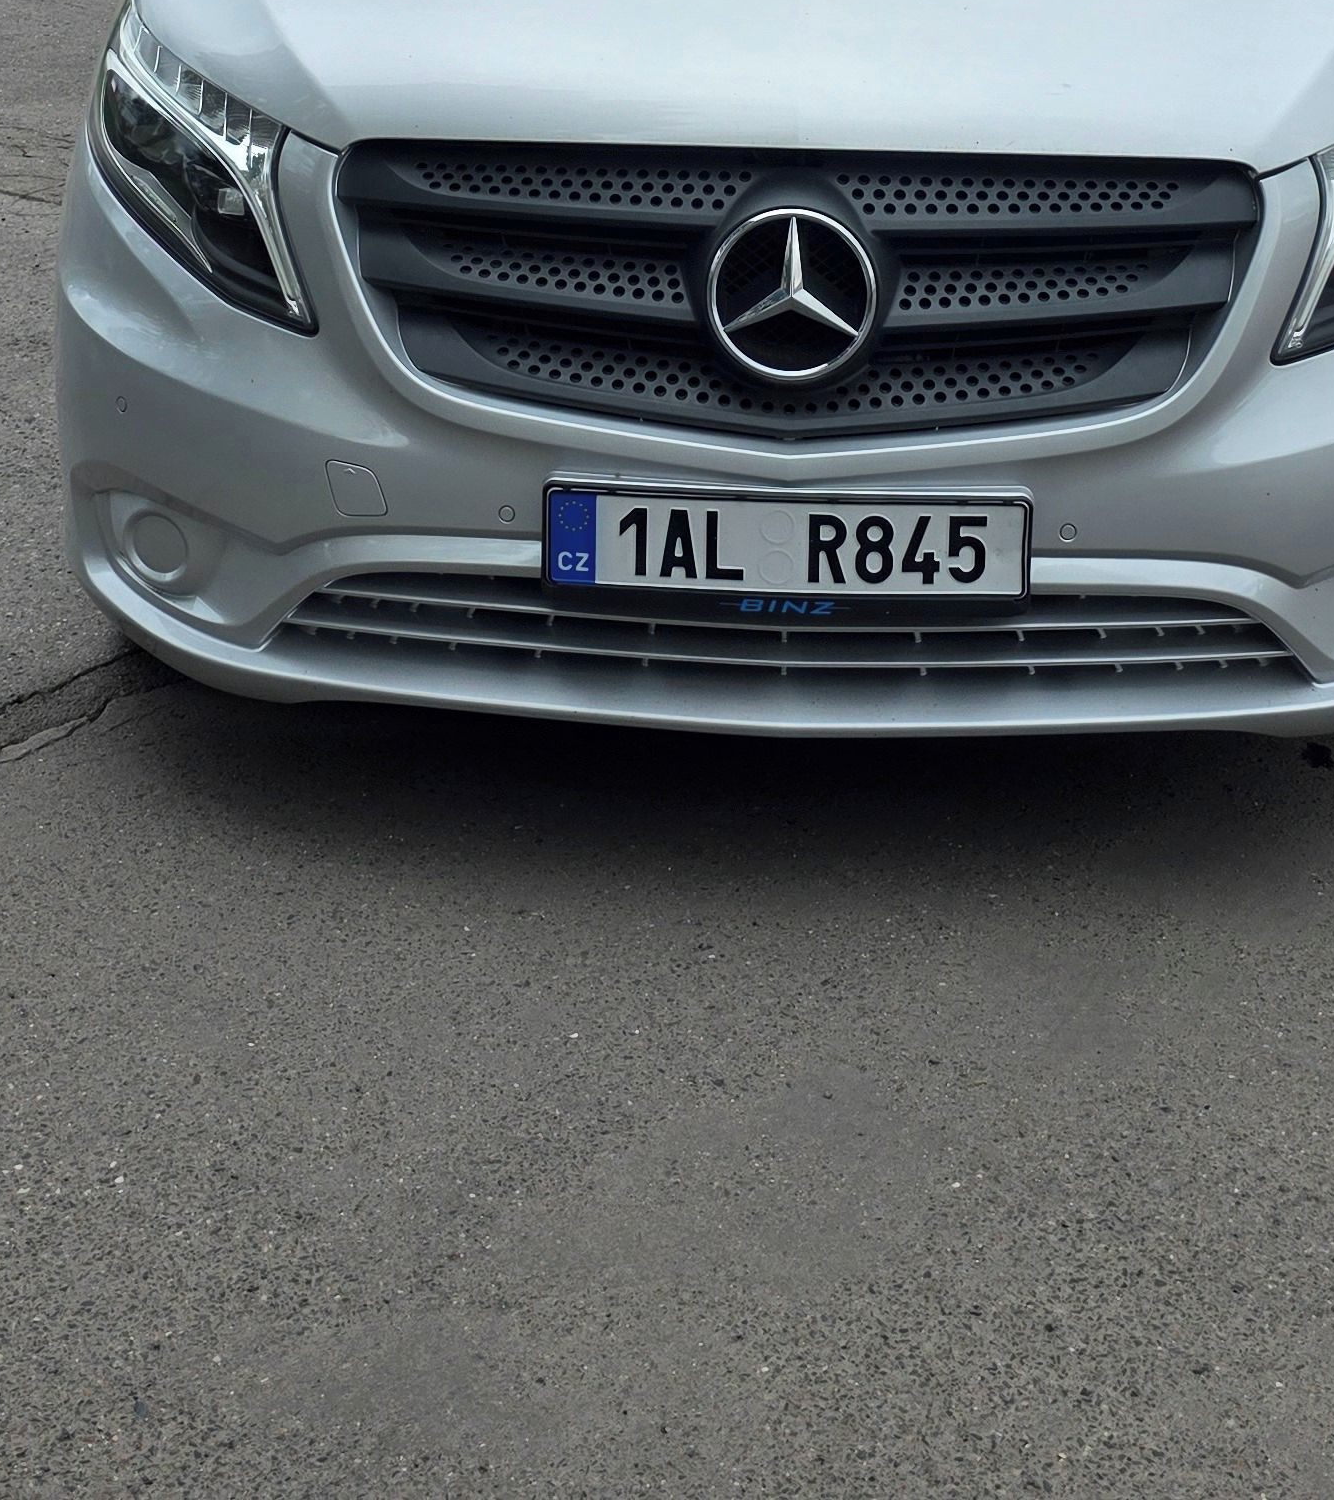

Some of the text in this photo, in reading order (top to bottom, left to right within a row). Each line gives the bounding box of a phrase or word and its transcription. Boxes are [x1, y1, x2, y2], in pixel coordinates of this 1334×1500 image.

[619, 507, 988, 585] 1AL R845
[557, 551, 590, 573] CZ
[739, 598, 835, 615] BINZ
